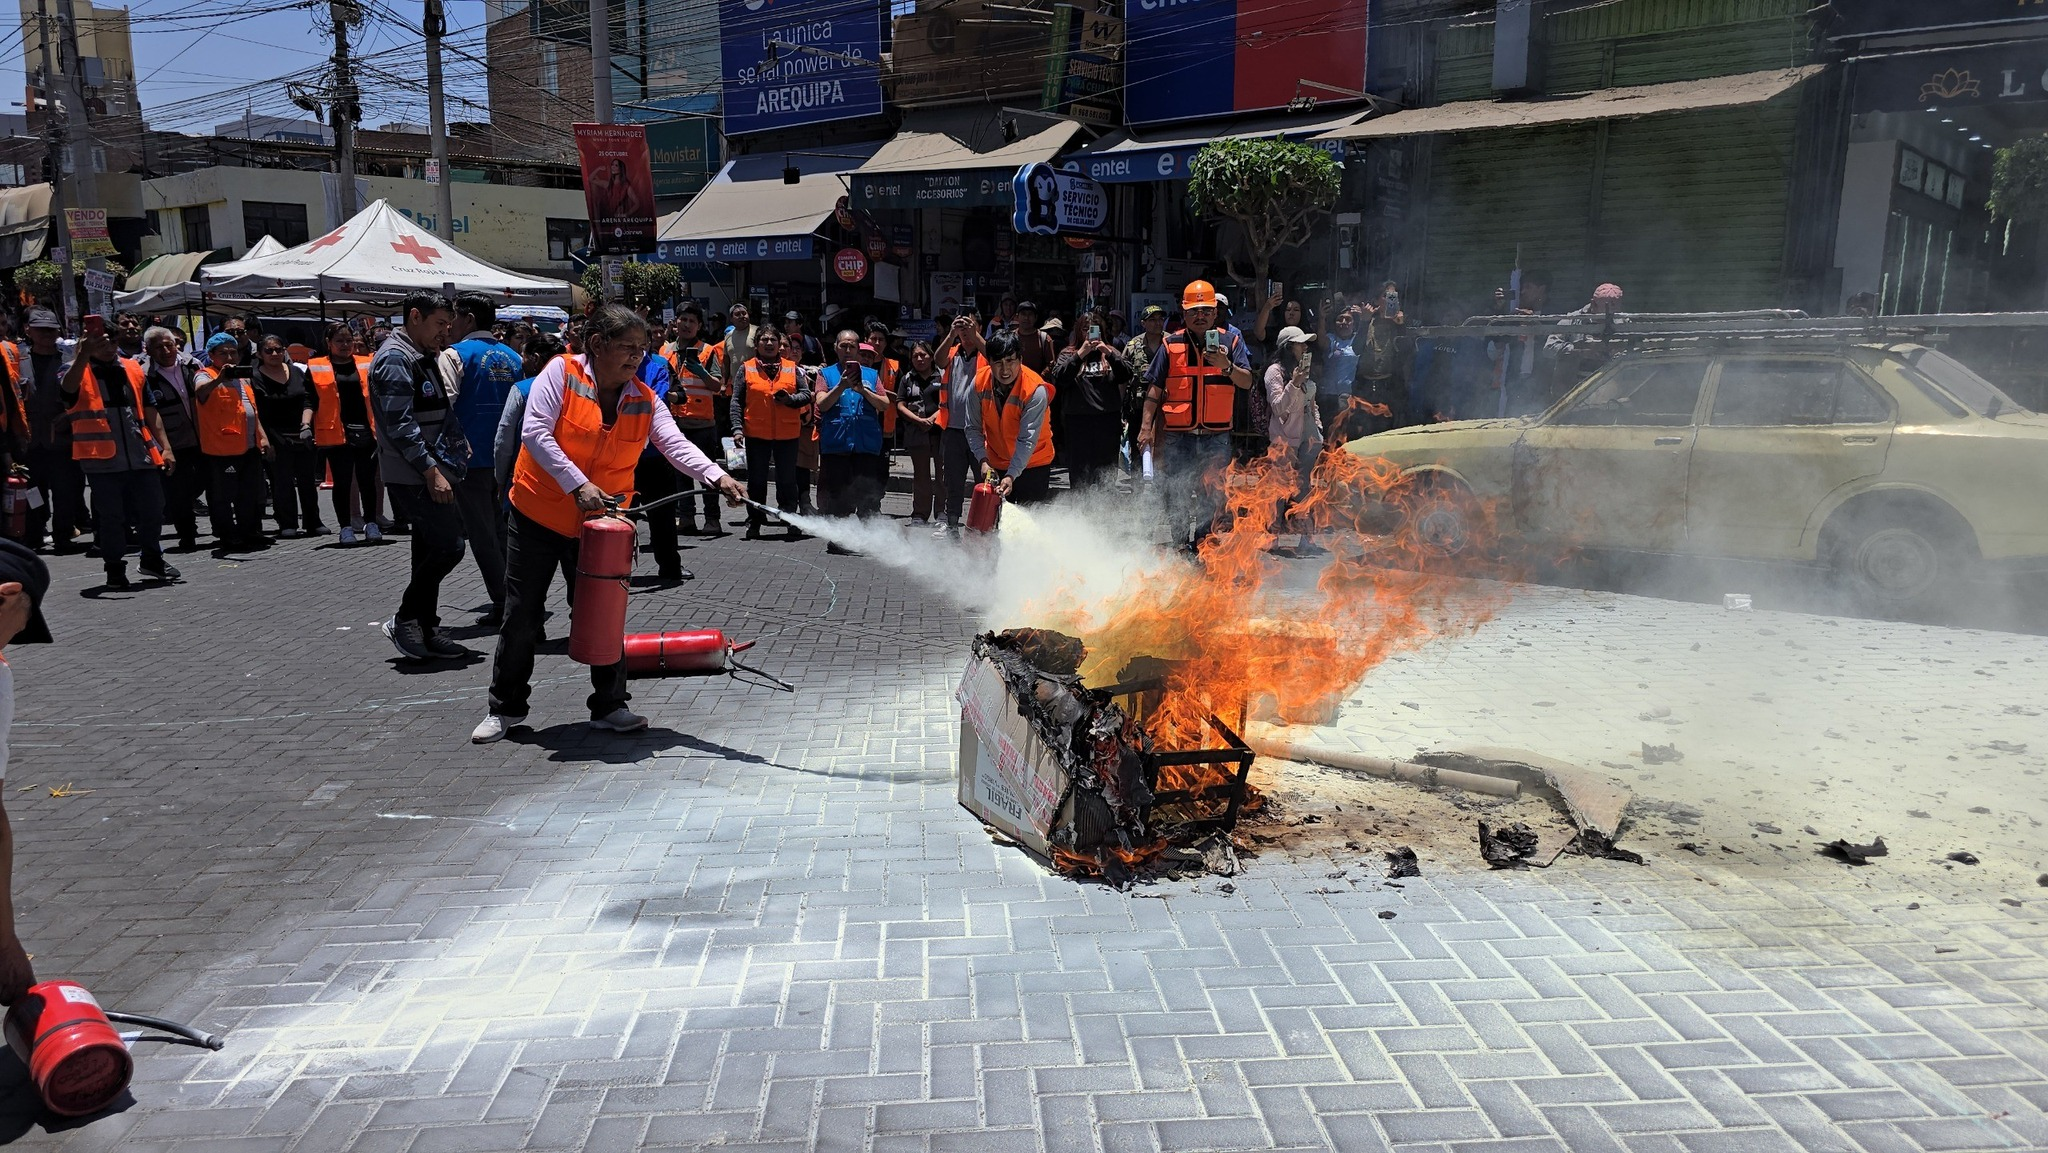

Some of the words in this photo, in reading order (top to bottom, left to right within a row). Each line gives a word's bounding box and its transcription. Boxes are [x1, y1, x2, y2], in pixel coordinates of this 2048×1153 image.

[762, 28, 782, 50] La
[786, 18, 832, 45] única
[784, 54, 834, 84] power
[840, 44, 863, 68] de
[1069, 58, 1099, 80] SERVICIO
[756, 79, 845, 116] AREQUIPA
[577, 129, 603, 137] MYRIAM
[653, 145, 701, 164] Movistar
[1091, 158, 1131, 177] entel
[878, 184, 901, 197] entel
[1063, 190, 1100, 206] SERVICIO
[1063, 200, 1098, 219] TÉCNICO
[416, 210, 470, 234] biel
[622, 216, 653, 224] AREQUIPA
[674, 243, 699, 257] entel
[722, 241, 748, 256] entel
[774, 238, 802, 253] entel
[391, 265, 415, 273] Cruz
[415, 267, 439, 276] Roja
[440, 270, 480, 278] Peruana
[837, 260, 864, 270] CHIP
[356, 285, 370, 293] Cruz
[370, 286, 384, 295] Roja
[985, 786, 1023, 821] FRAGIL
